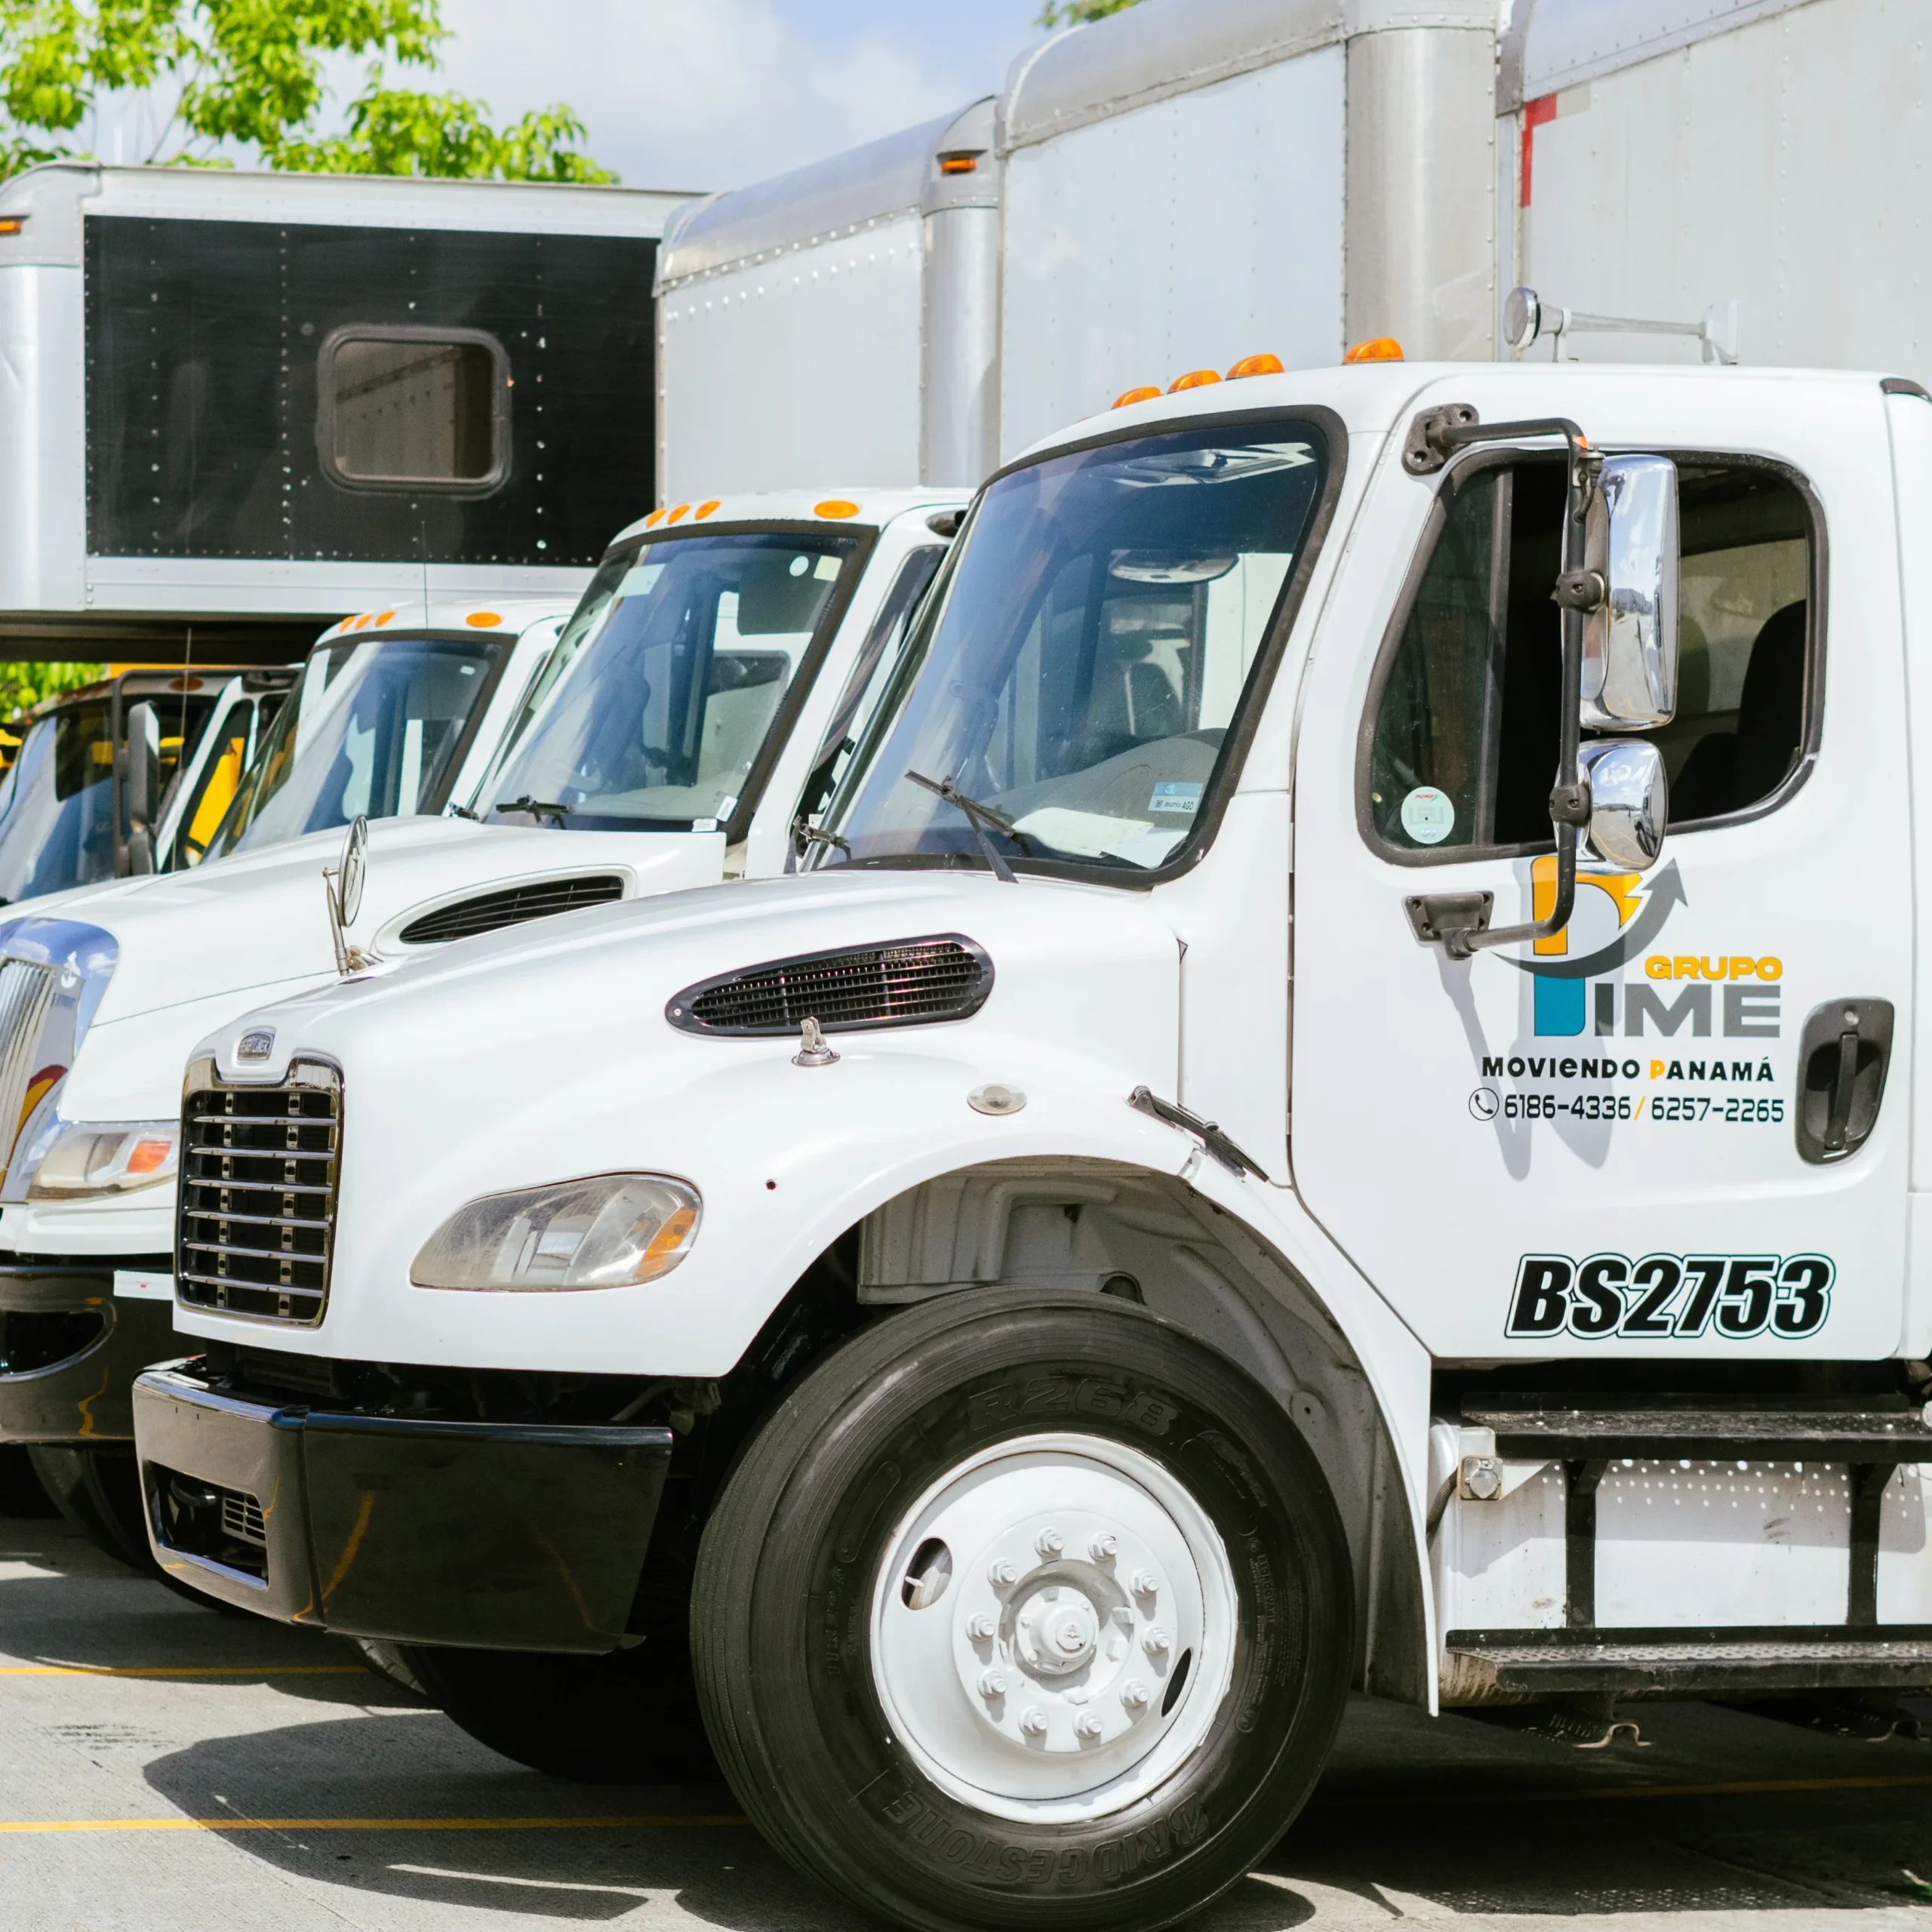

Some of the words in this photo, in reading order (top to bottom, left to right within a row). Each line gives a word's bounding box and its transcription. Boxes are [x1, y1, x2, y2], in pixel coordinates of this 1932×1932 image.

[1644, 955, 1783, 981] GRUPO
[1649, 1057, 1775, 1082] PANAMÁ
[1504, 1094, 1631, 1120] 6186-4336
[1651, 1097, 1784, 1122] 6257-2265
[1504, 1253, 1836, 1340] BS2753
[968, 1376, 1179, 1437] R268
[882, 1790, 1208, 1885] BRIDGESTONE
